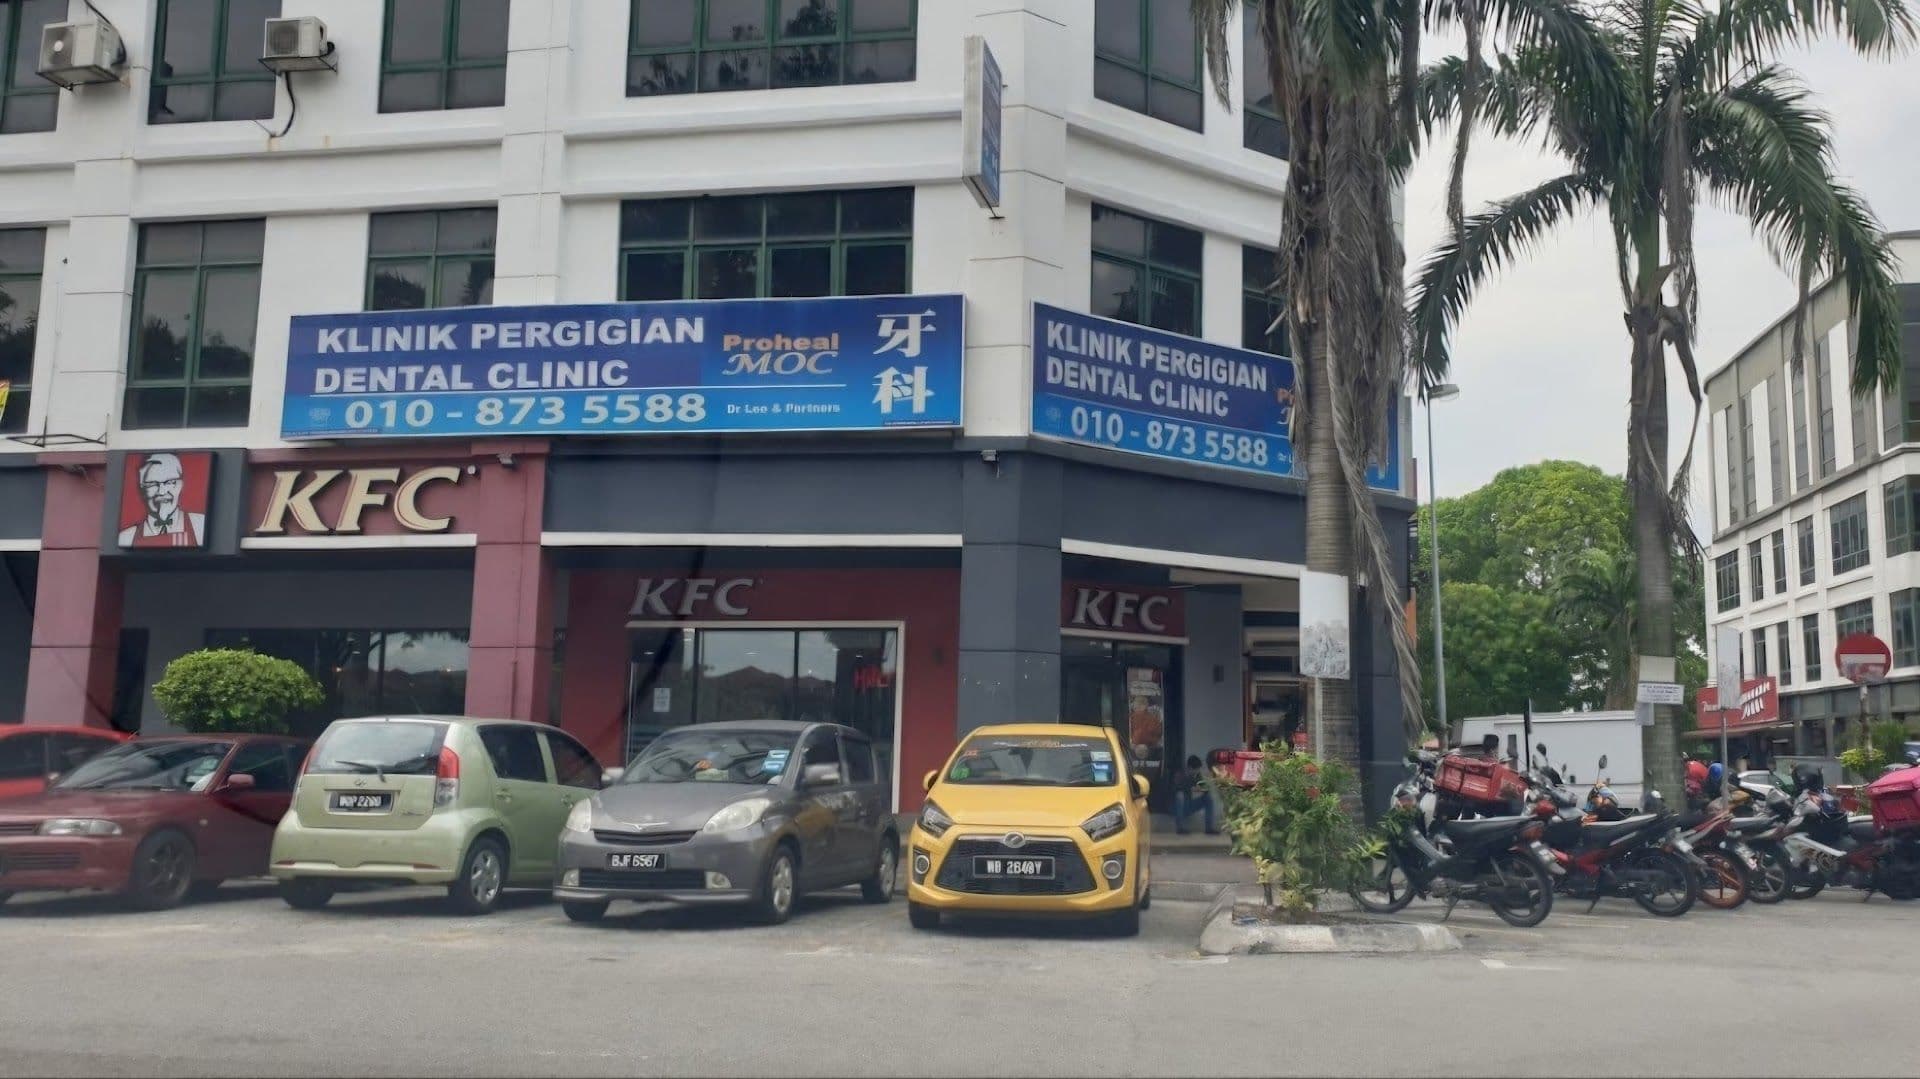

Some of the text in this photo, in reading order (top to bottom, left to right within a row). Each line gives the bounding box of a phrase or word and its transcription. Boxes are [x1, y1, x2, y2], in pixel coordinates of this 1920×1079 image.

[316, 317, 705, 354] KLINIK PERGIGIAN
[723, 332, 839, 351] Proheal
[722, 350, 839, 376] MOC
[872, 307, 937, 414] 牙科
[1047, 320, 1268, 392] KLINIK PERGIGIAN
[315, 359, 629, 394] DENTAL CLINIC
[1046, 355, 1142, 401] DENTAL
[1150, 379, 1229, 417] CLINIC
[344, 399, 434, 429] 010
[474, 396, 566, 426] 873
[581, 393, 706, 425] 5588
[727, 404, 742, 414] Dr
[785, 403, 841, 414] Partners
[1070, 406, 1124, 443] 010
[1147, 420, 1196, 456] 873
[1204, 431, 1269, 467] 5588
[254, 465, 463, 536] KFC
[628, 577, 754, 616] KFC
[1071, 587, 1169, 632] KFC
